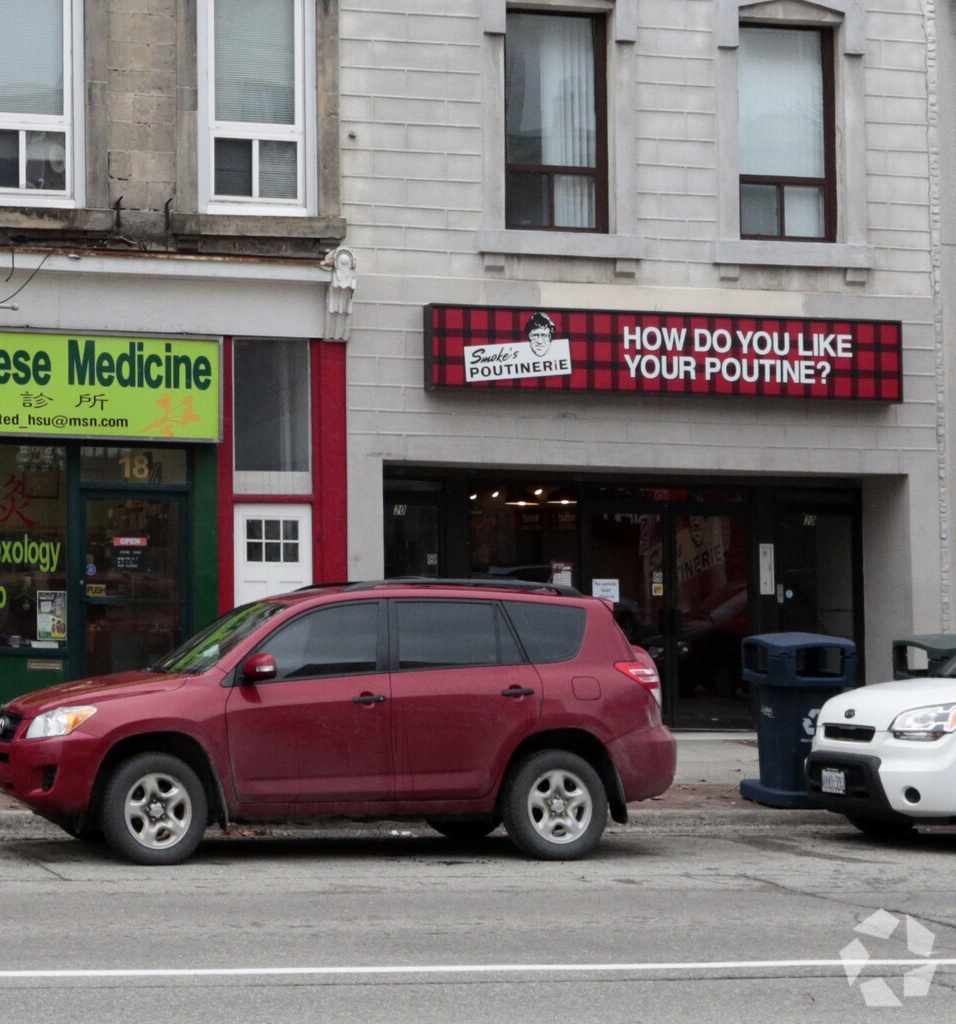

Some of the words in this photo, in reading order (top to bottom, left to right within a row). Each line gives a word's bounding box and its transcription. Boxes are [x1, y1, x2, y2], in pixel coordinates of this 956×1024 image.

[623, 326, 686, 351] HOW
[694, 328, 732, 353] DO
[736, 330, 790, 356] YOU
[798, 333, 853, 358] LIKE
[68, 339, 212, 390] Medicine
[470, 348, 519, 365] Smoke's
[624, 354, 696, 379] YOUR
[705, 357, 831, 384] POUTINE?
[118, 455, 150, 479] 18
[120, 537, 141, 545] OPEN
[86, 585, 106, 595] PUSH
